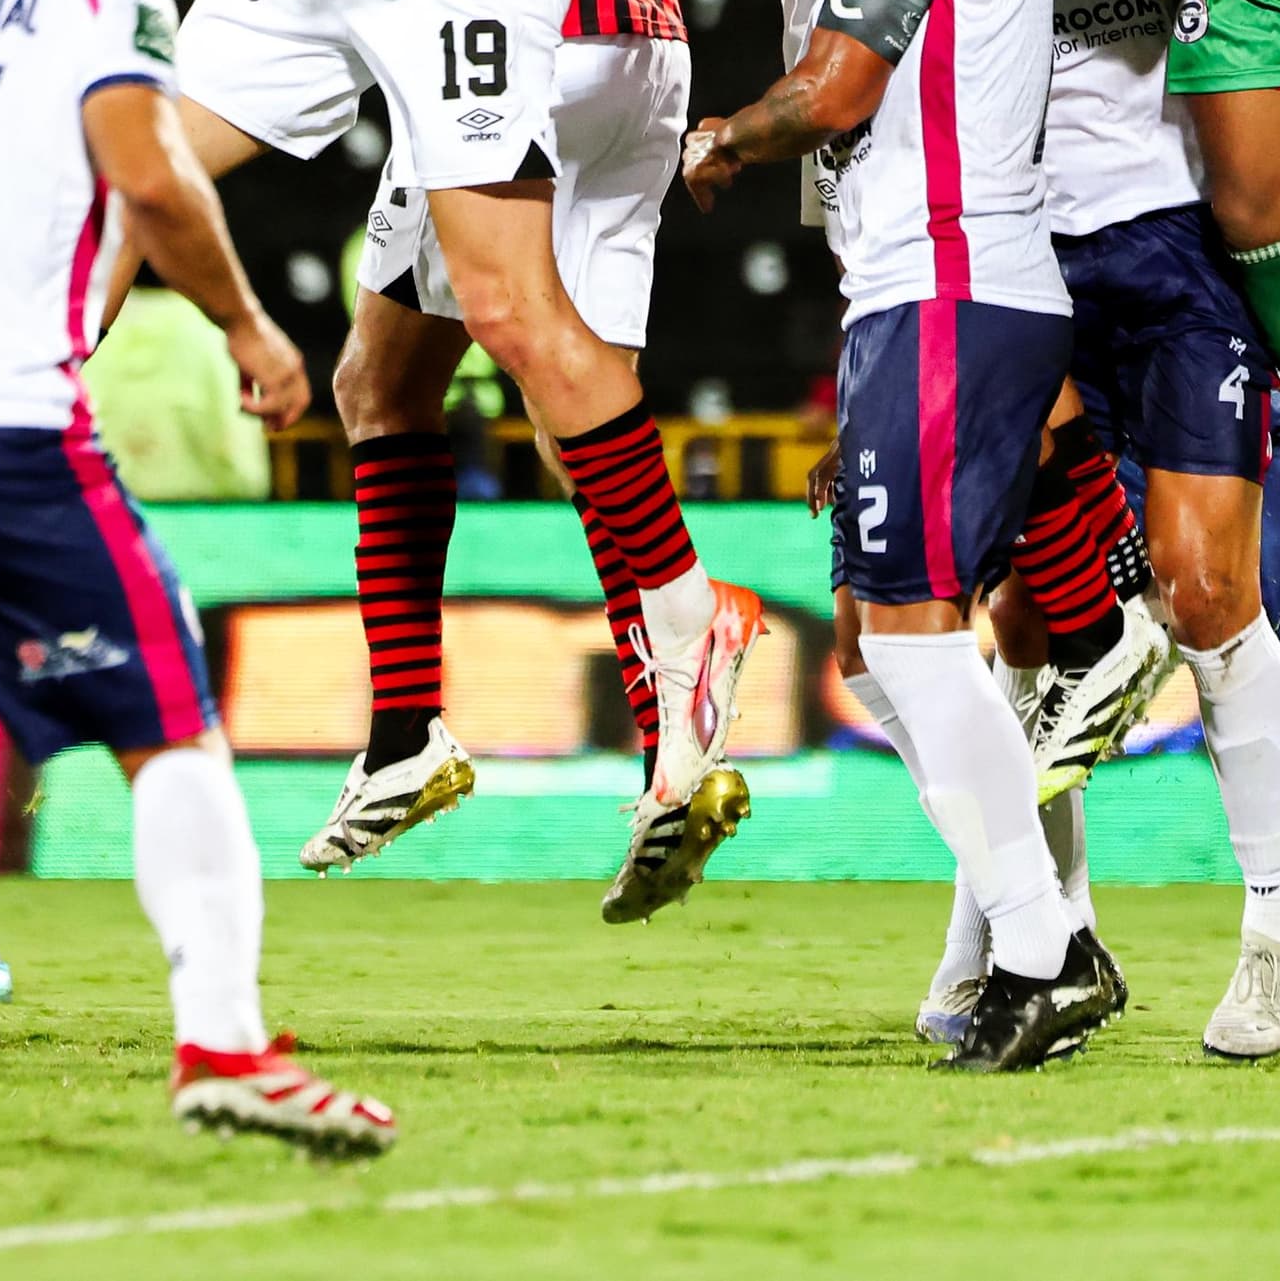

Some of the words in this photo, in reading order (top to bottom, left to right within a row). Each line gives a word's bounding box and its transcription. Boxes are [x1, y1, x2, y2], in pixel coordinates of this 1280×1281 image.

[439, 19, 508, 101] 19
[1084, 19, 1166, 50] Internet
[462, 131, 502, 143] umbro
[1218, 364, 1250, 421] 4
[857, 484, 889, 554] 2
